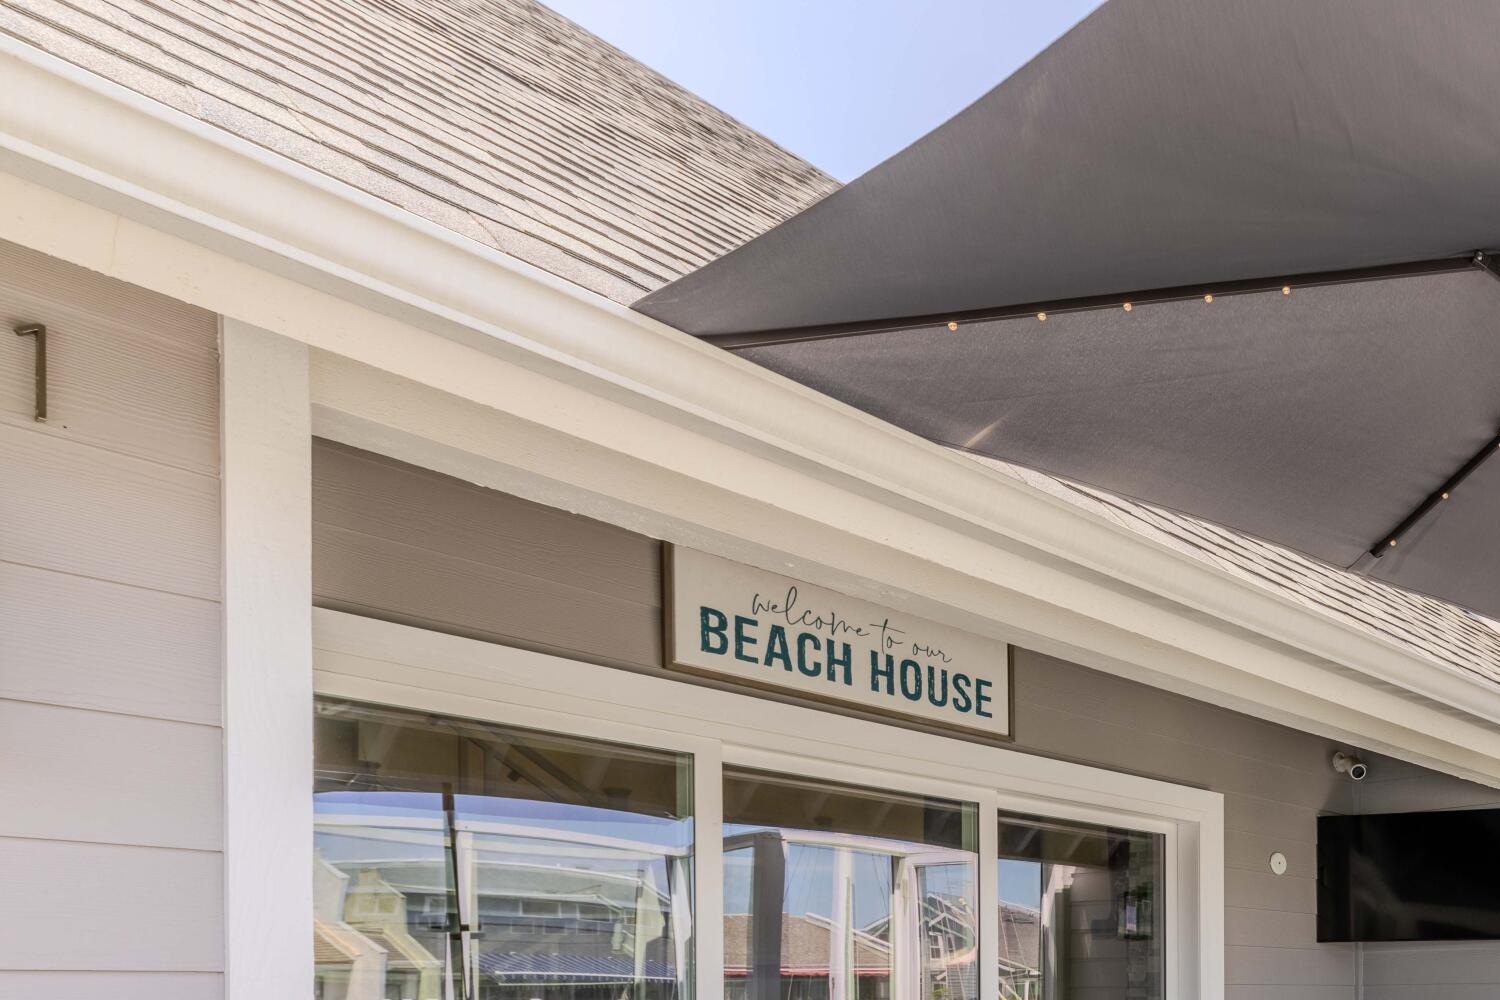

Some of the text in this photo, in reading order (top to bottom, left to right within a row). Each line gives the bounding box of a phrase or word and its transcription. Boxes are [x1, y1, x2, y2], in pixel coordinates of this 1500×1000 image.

[700, 605, 993, 718] BEACH HOUSE
[752, 586, 953, 663] welcome to our
